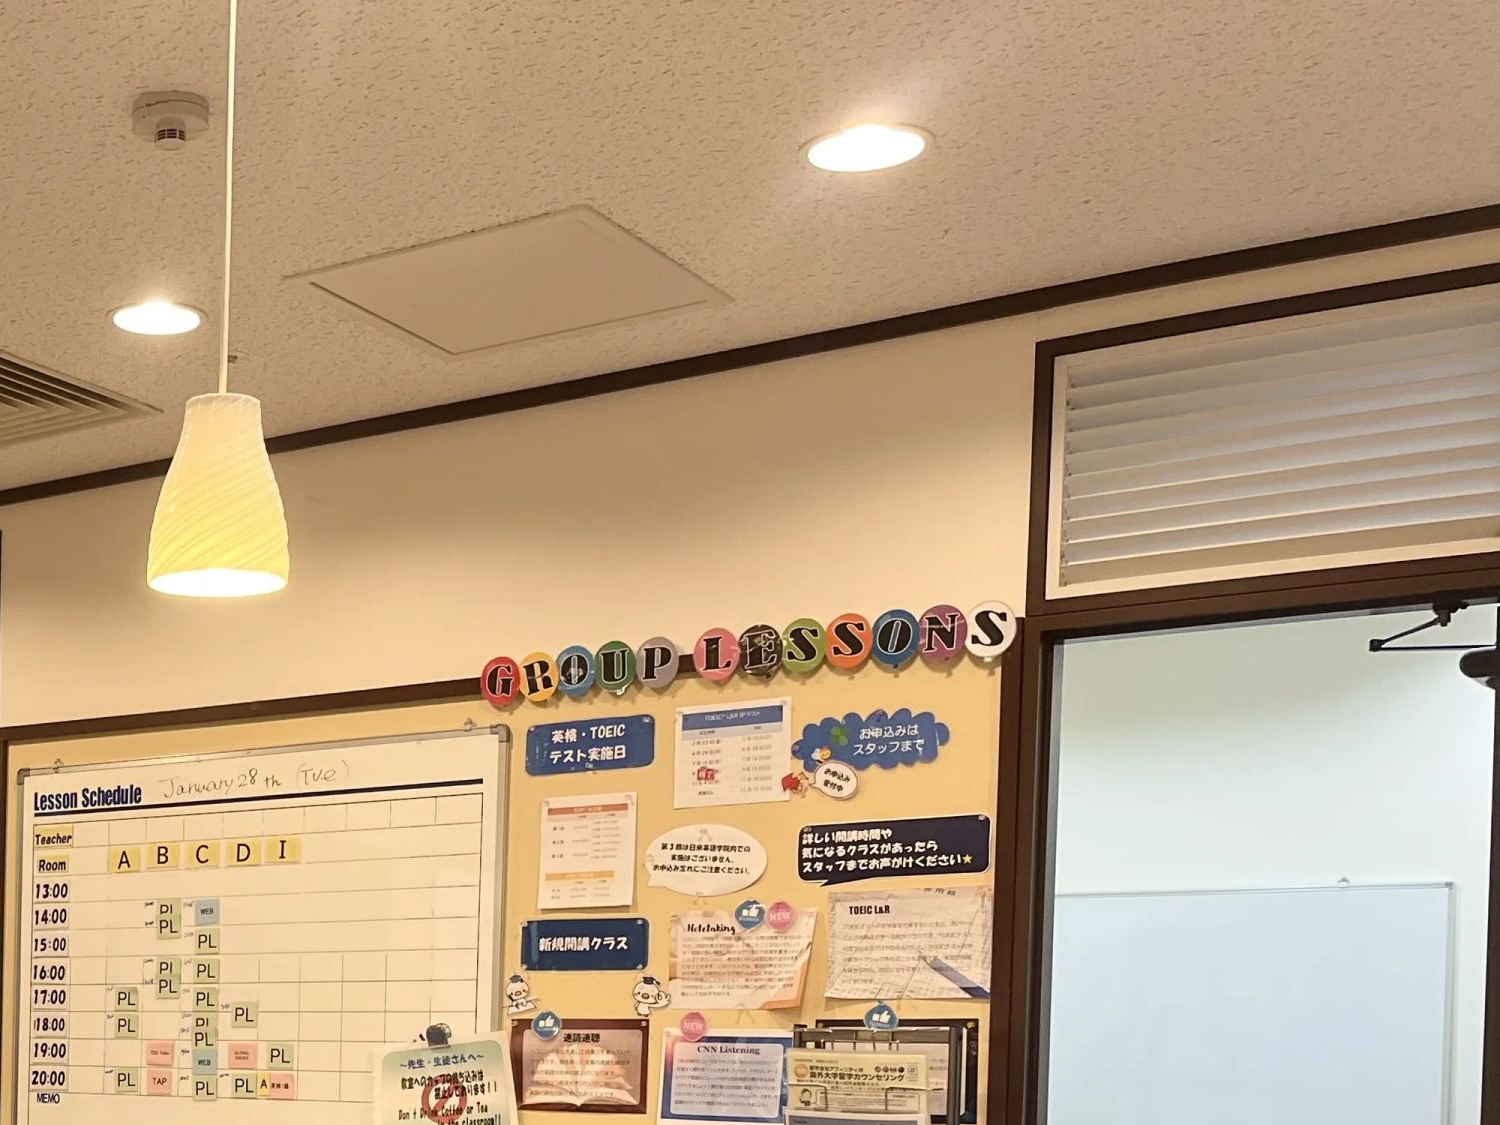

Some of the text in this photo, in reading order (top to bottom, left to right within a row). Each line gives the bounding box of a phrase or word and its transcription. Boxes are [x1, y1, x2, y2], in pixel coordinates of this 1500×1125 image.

[487, 610, 1008, 698] GROUP LESSONS
[551, 723, 626, 745] 英検・TOEIC
[859, 724, 919, 740] お申込みは
[549, 744, 626, 764] テスト実施日
[853, 739, 925, 756] スタッフまで
[158, 776, 234, 798] January
[237, 767, 258, 787] 28
[824, 768, 851, 783] お申込み
[823, 780, 844, 793] 受付中
[33, 784, 142, 811] Lesson Schedule
[35, 833, 72, 846] Teacher
[802, 828, 893, 844] 詳しい開講時間や
[38, 859, 67, 871] Room
[118, 851, 131, 869] A
[157, 845, 169, 864] B
[196, 844, 209, 863] C
[236, 843, 251, 862] D
[802, 841, 938, 859] 気になるクラスがあったら
[35, 883, 68, 899] 13:00
[34, 908, 67, 925] 14:00
[200, 907, 214, 915] WEB
[769, 911, 791, 921] NEW
[849, 905, 890, 915] TOEIC L&R
[159, 919, 178, 934] PL
[687, 923, 736, 936] Notetaking
[34, 934, 217, 952] 15:00 PL
[539, 936, 628, 953] 新規開講クラス
[33, 965, 65, 981] 16:00
[197, 963, 216, 979] PL
[159, 979, 177, 994] PL
[33, 989, 215, 1007] 17:00 PL PL
[235, 1007, 254, 1022] PL
[35, 1017, 65, 1032] 18:00
[117, 1017, 136, 1033] PL
[683, 1022, 704, 1031] NEW
[195, 1032, 214, 1047] PL
[563, 1033, 601, 1043] 速読速聴
[33, 1042, 65, 1058] 19:00
[270, 1048, 290, 1064] PL
[697, 1045, 761, 1055] CNN Listening
[31, 1070, 136, 1087] 20:00 PL
[152, 1077, 167, 1086] TAP
[234, 1078, 254, 1093] PL
[195, 1081, 215, 1096] PL
[36, 1093, 60, 1104] MEMO
[441, 1104, 463, 1117] Coffee
[466, 1104, 474, 1115] or
[476, 1101, 488, 1113] Tea
